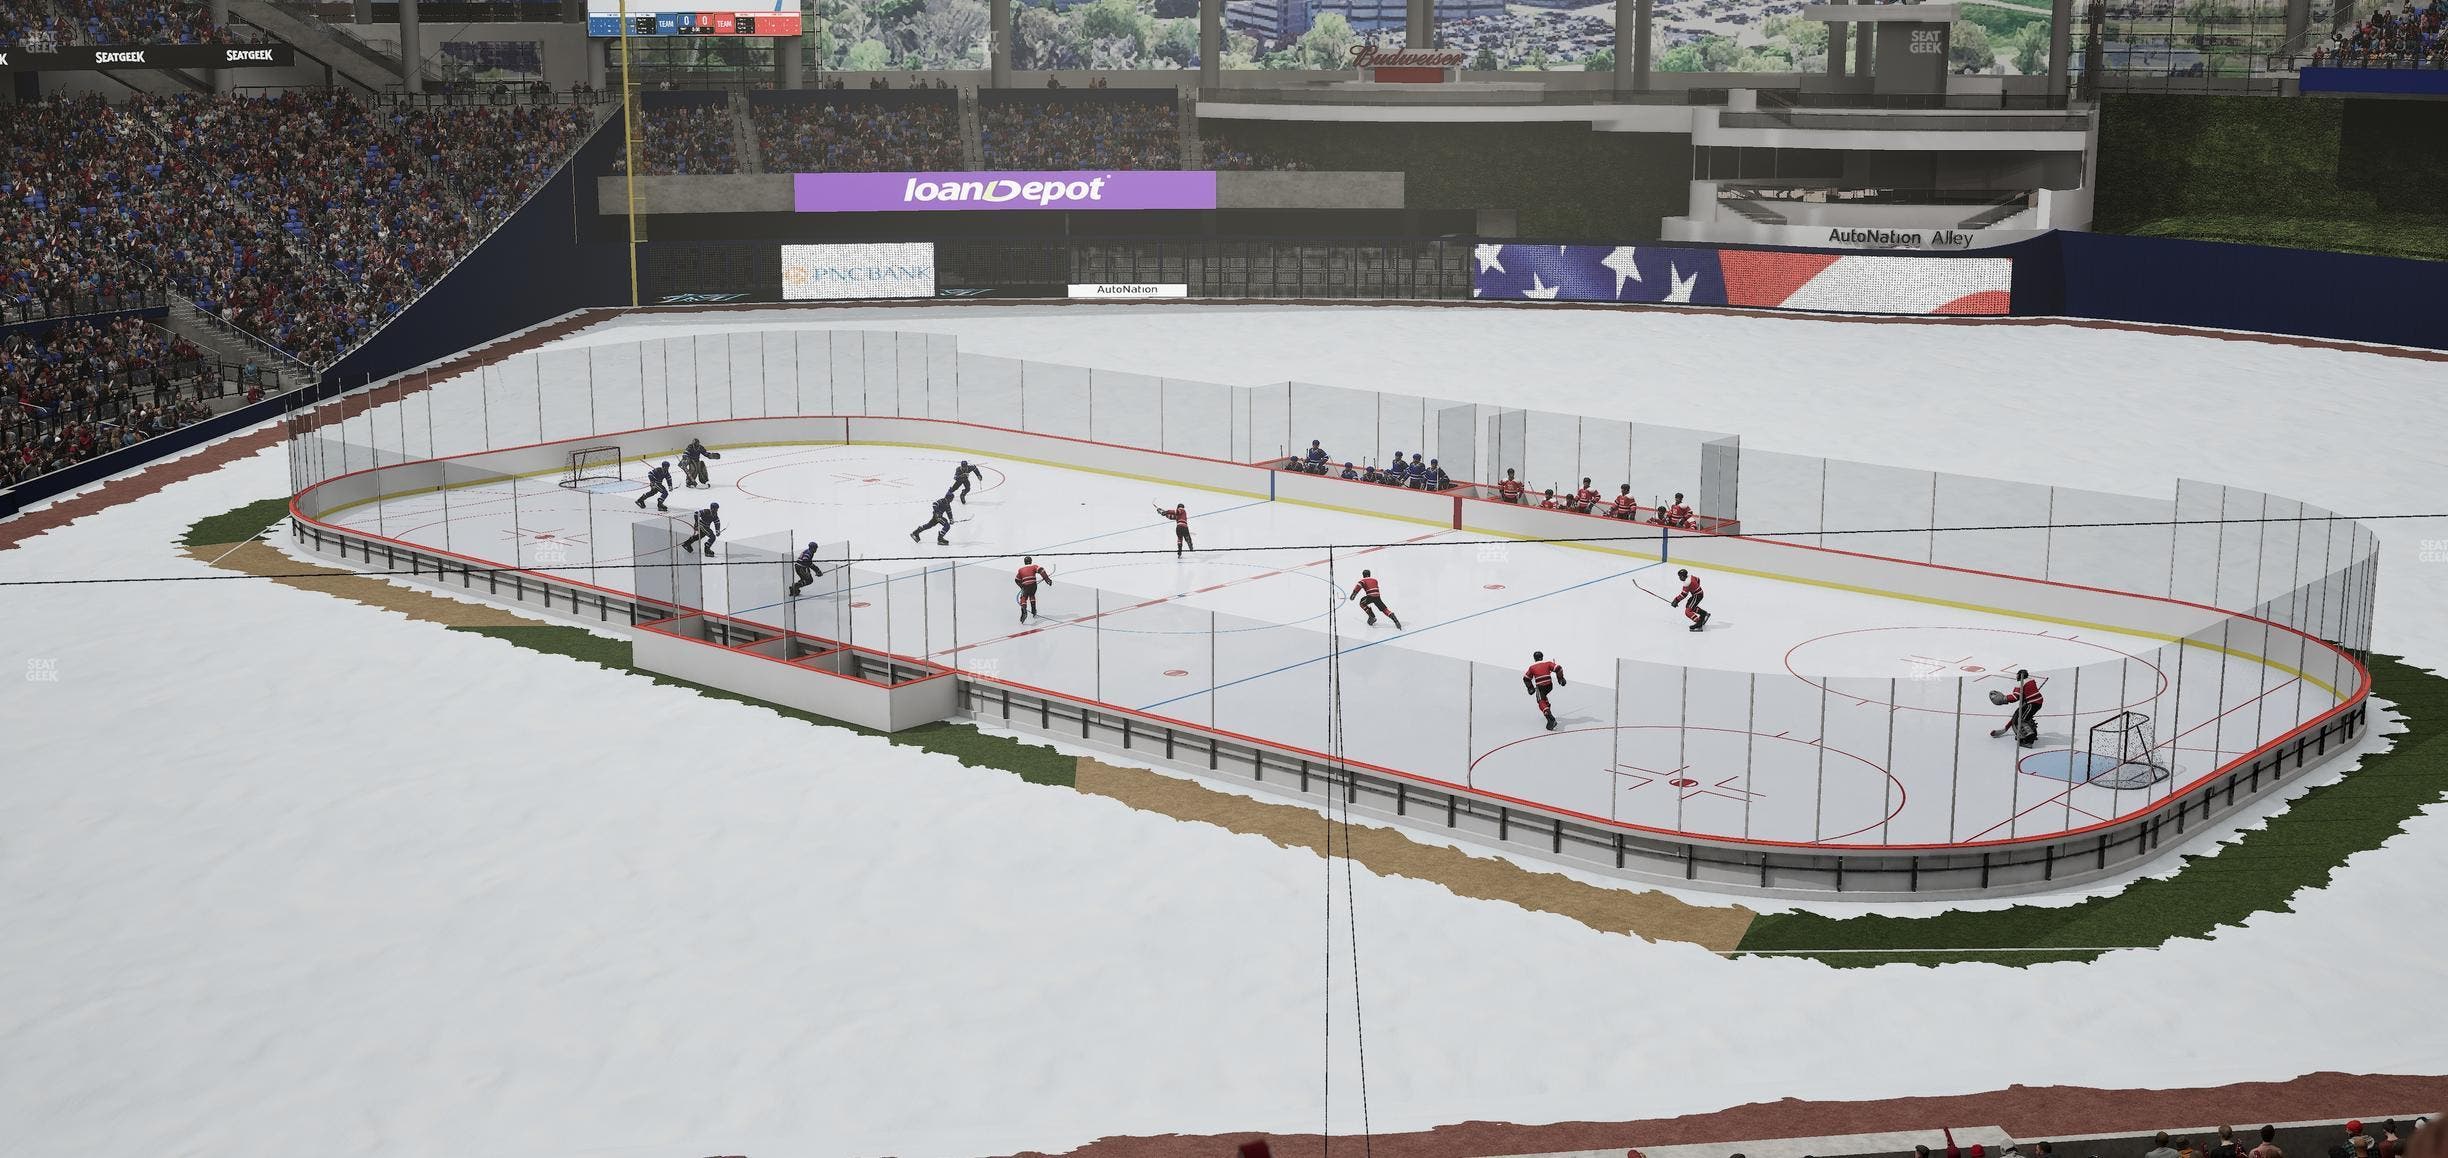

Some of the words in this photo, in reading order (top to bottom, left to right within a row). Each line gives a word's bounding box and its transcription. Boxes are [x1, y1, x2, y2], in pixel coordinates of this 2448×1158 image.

[659, 20, 674, 28] TEAM
[684, 16, 689, 26] 0
[702, 16, 707, 26] 0
[717, 20, 732, 28] TEAM
[95, 51, 146, 64] SEATGEEK
[226, 49, 273, 61] SEATGEEK
[1350, 45, 1465, 68] Budweiser
[904, 177, 1105, 206] loanDepot
[1829, 228, 1921, 245] AutoNation
[1931, 230, 1974, 249] Alley
[1097, 285, 1158, 294] AutoNation
